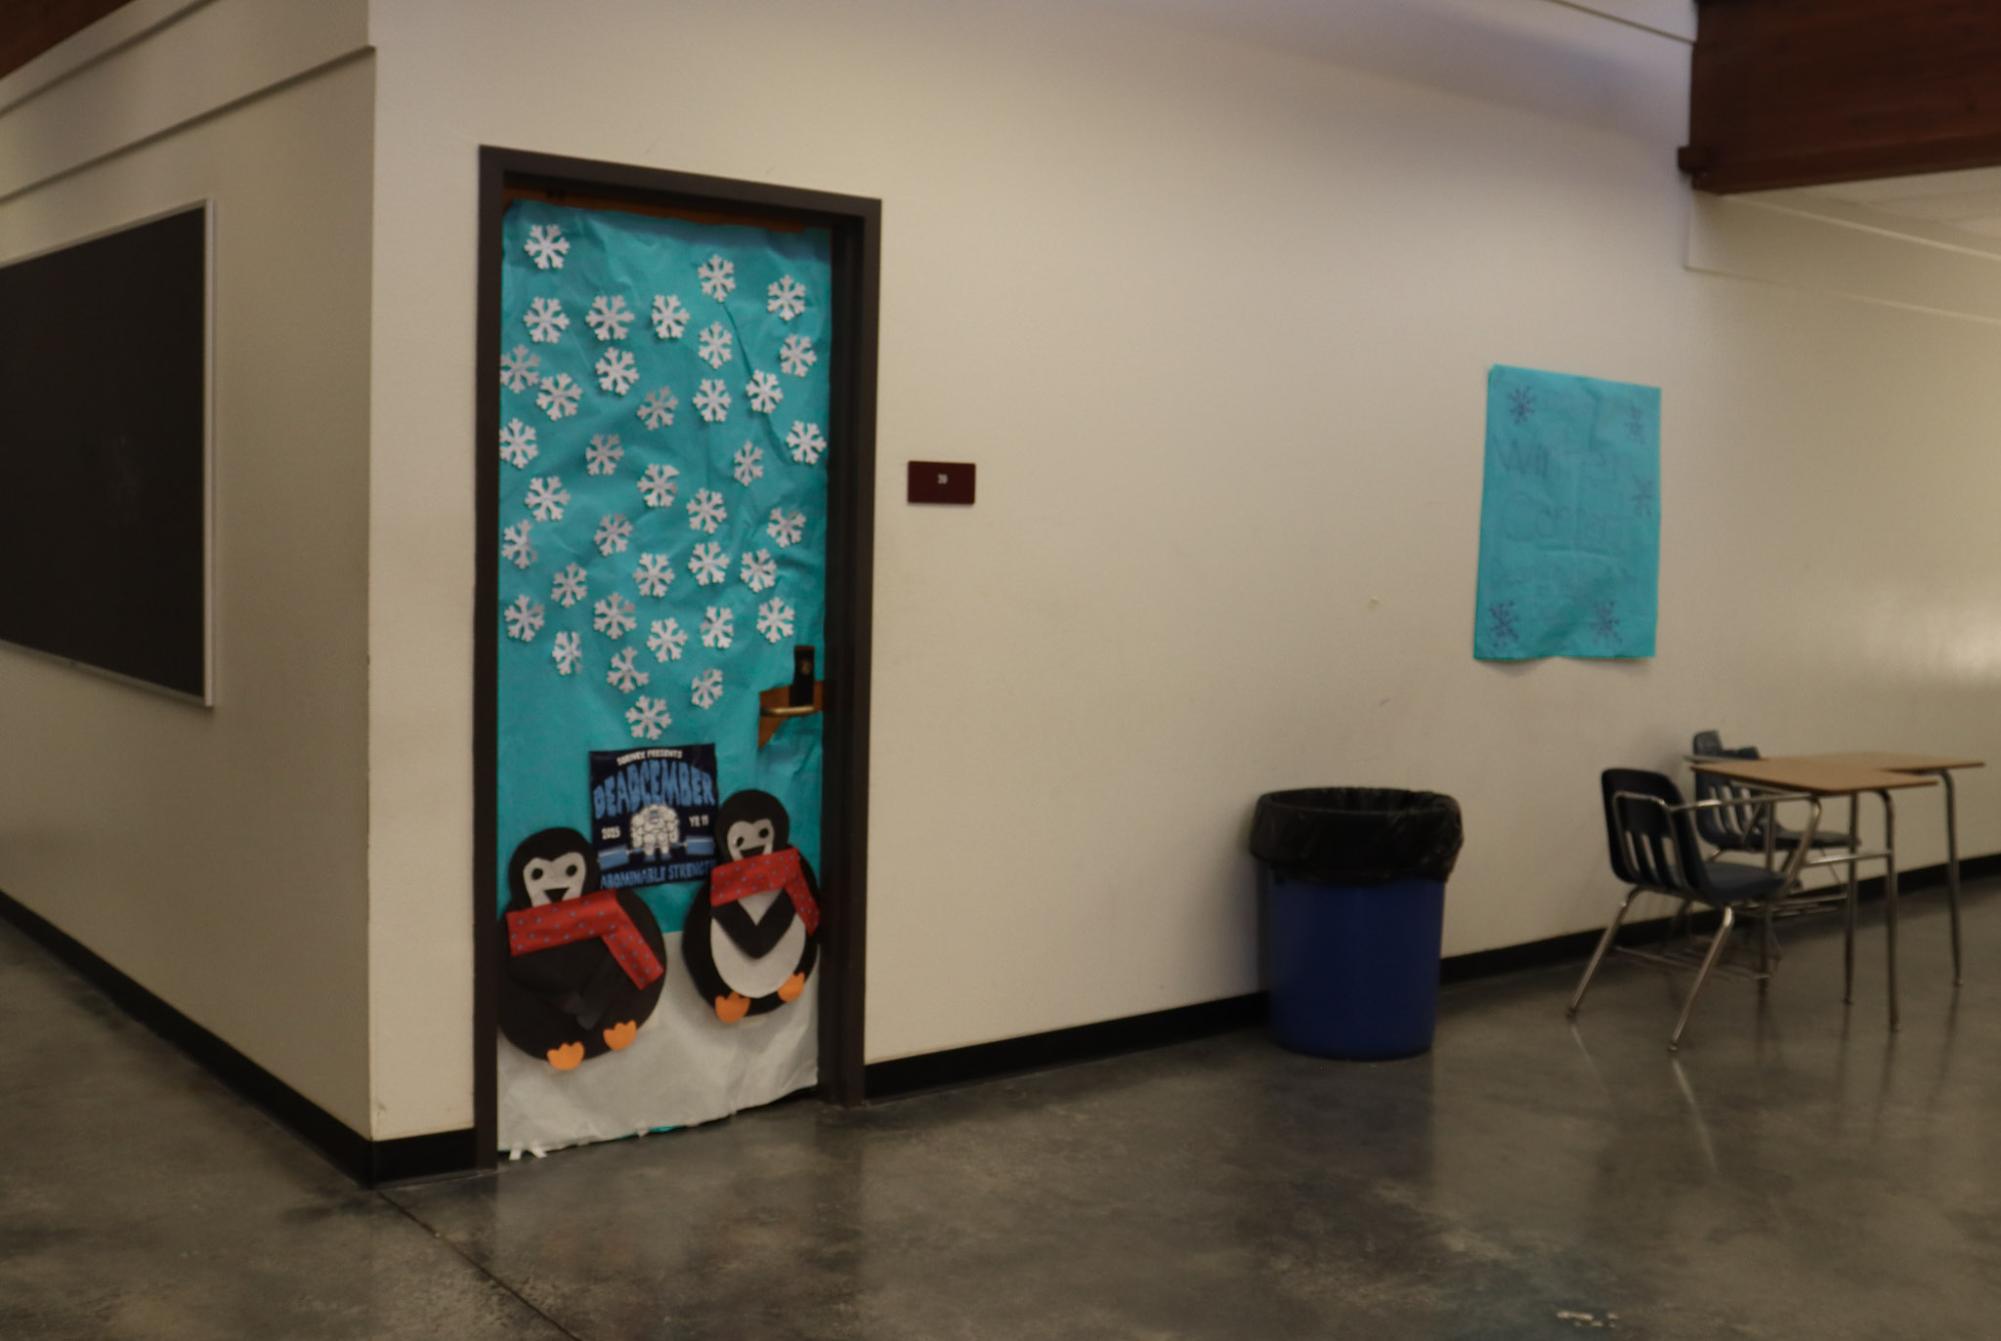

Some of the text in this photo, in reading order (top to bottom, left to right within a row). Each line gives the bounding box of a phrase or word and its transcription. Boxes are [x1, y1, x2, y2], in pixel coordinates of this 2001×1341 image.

[647, 749, 683, 759] PRESENTS
[593, 759, 715, 818] DEADCEMBER
[601, 867, 666, 889] ABOMINABLE
